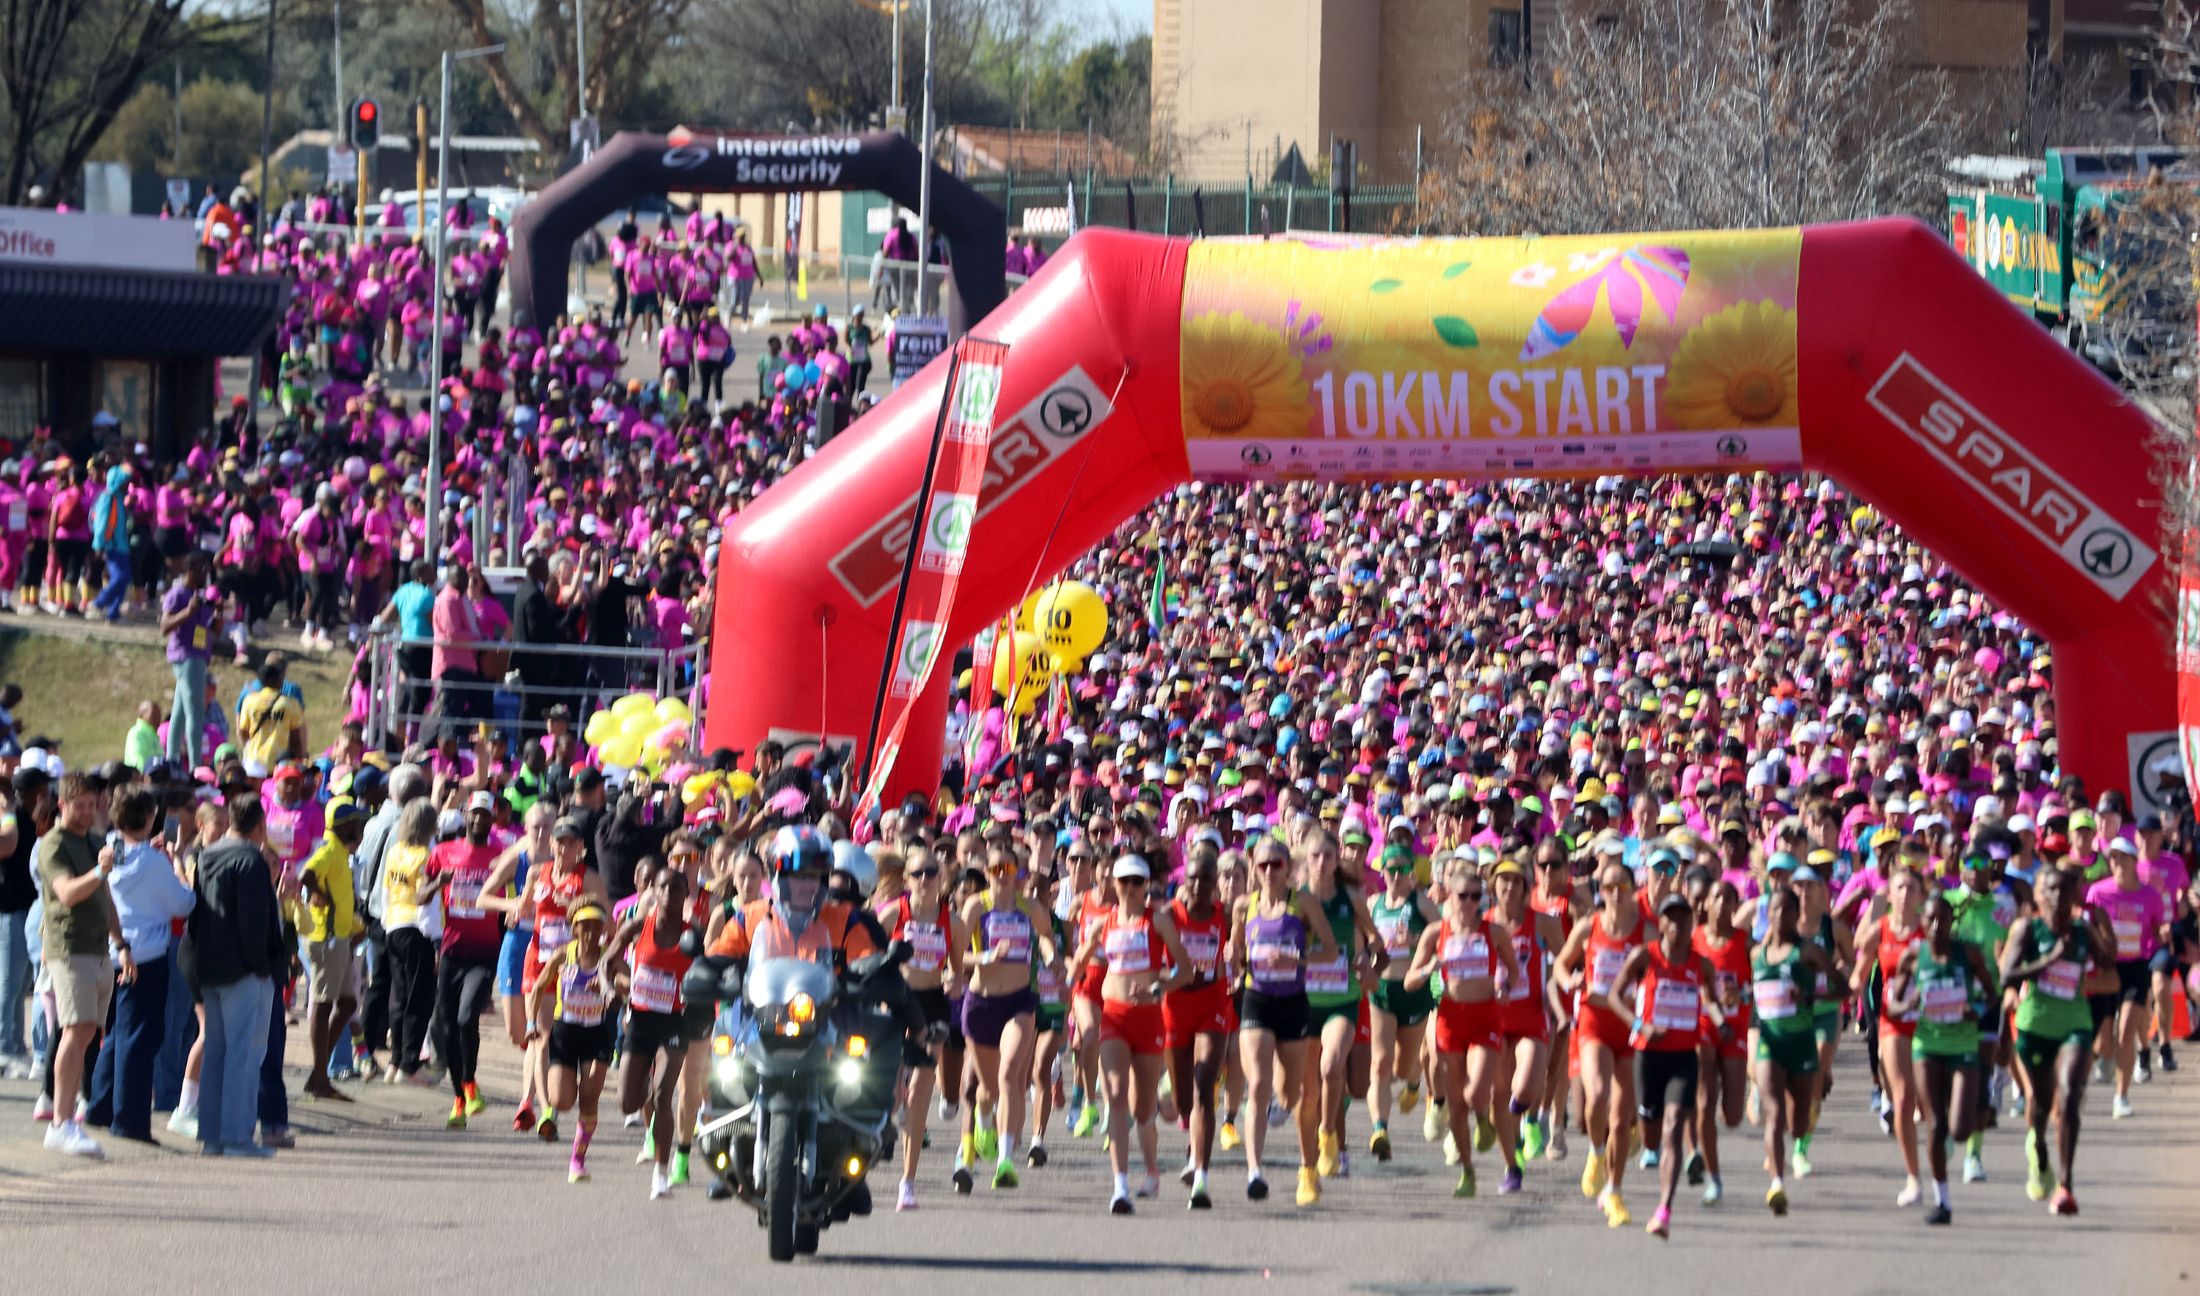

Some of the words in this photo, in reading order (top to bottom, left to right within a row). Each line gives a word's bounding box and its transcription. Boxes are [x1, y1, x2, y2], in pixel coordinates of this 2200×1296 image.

[717, 136, 861, 157] Interactive
[736, 157, 842, 186] Security
[899, 335, 943, 354] rent
[1313, 370, 1471, 440] 10KM
[1488, 363, 1666, 437] START
[1920, 400, 2077, 536] SPAR
[1046, 608, 1072, 630] 10
